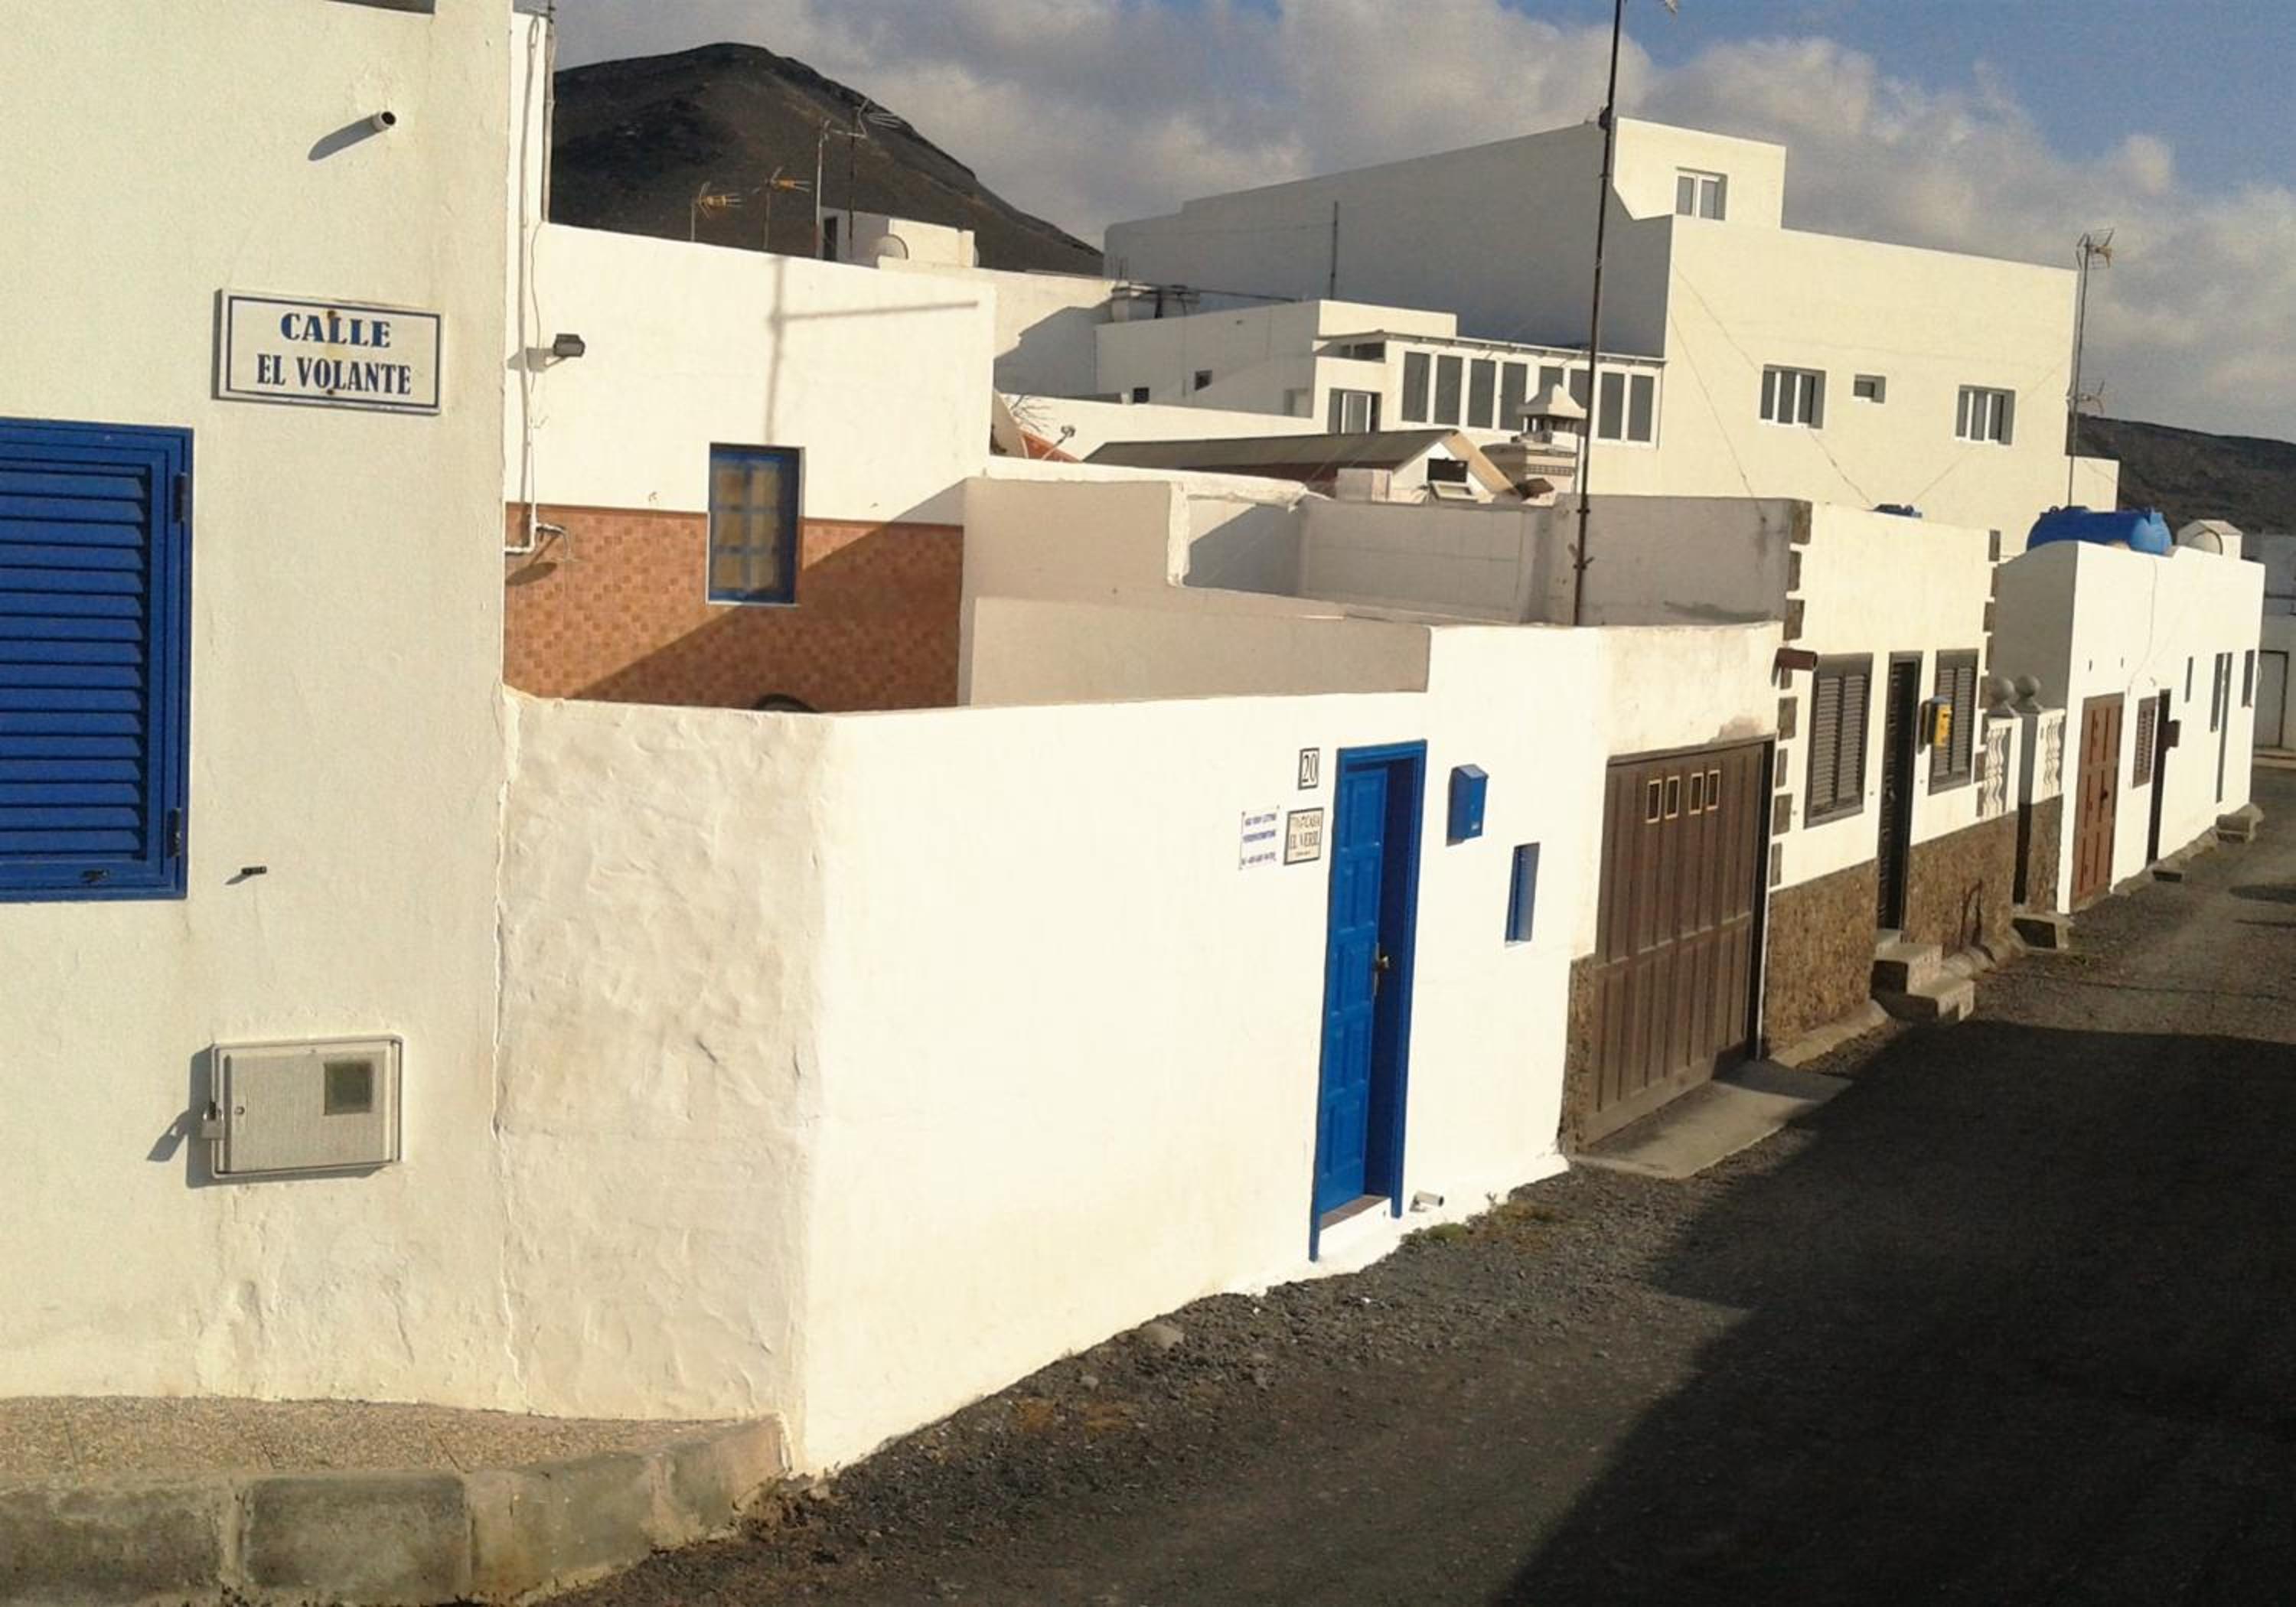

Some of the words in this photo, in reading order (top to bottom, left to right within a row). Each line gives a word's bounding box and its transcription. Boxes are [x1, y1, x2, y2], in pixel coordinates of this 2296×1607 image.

[280, 312, 391, 348] CALLE
[256, 353, 286, 386] EL
[296, 356, 412, 395] VOLANTE
[1302, 753, 1318, 783] 20
